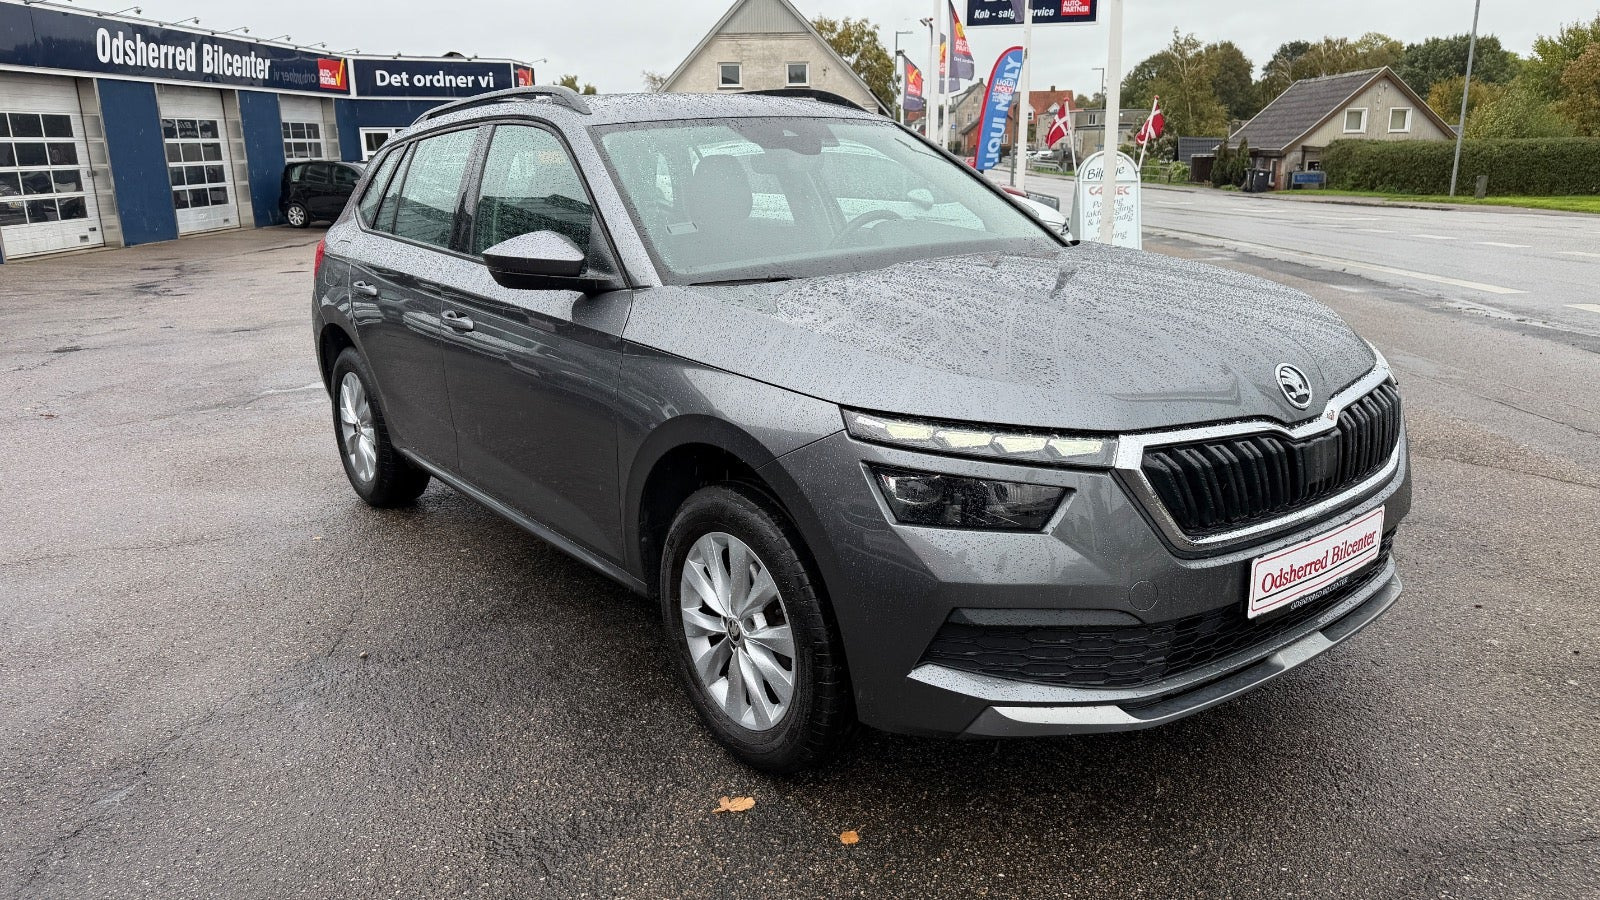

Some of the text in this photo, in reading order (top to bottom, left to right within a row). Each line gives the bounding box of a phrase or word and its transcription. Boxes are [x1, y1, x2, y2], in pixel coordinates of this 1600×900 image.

[974, 9, 990, 19] Køb
[998, 8, 1015, 20] salg
[1031, 7, 1055, 17] ervice
[1062, 5, 1089, 13] PARTNER
[96, 27, 271, 80] Odsherred Bilcenter
[375, 69, 494, 88] Det ordner vi
[984, 117, 1006, 168] LIQUI
[995, 55, 1022, 112] MLY
[1089, 185, 1131, 196] CAEC
[1261, 530, 1377, 594] Odsherred Bilcenter
